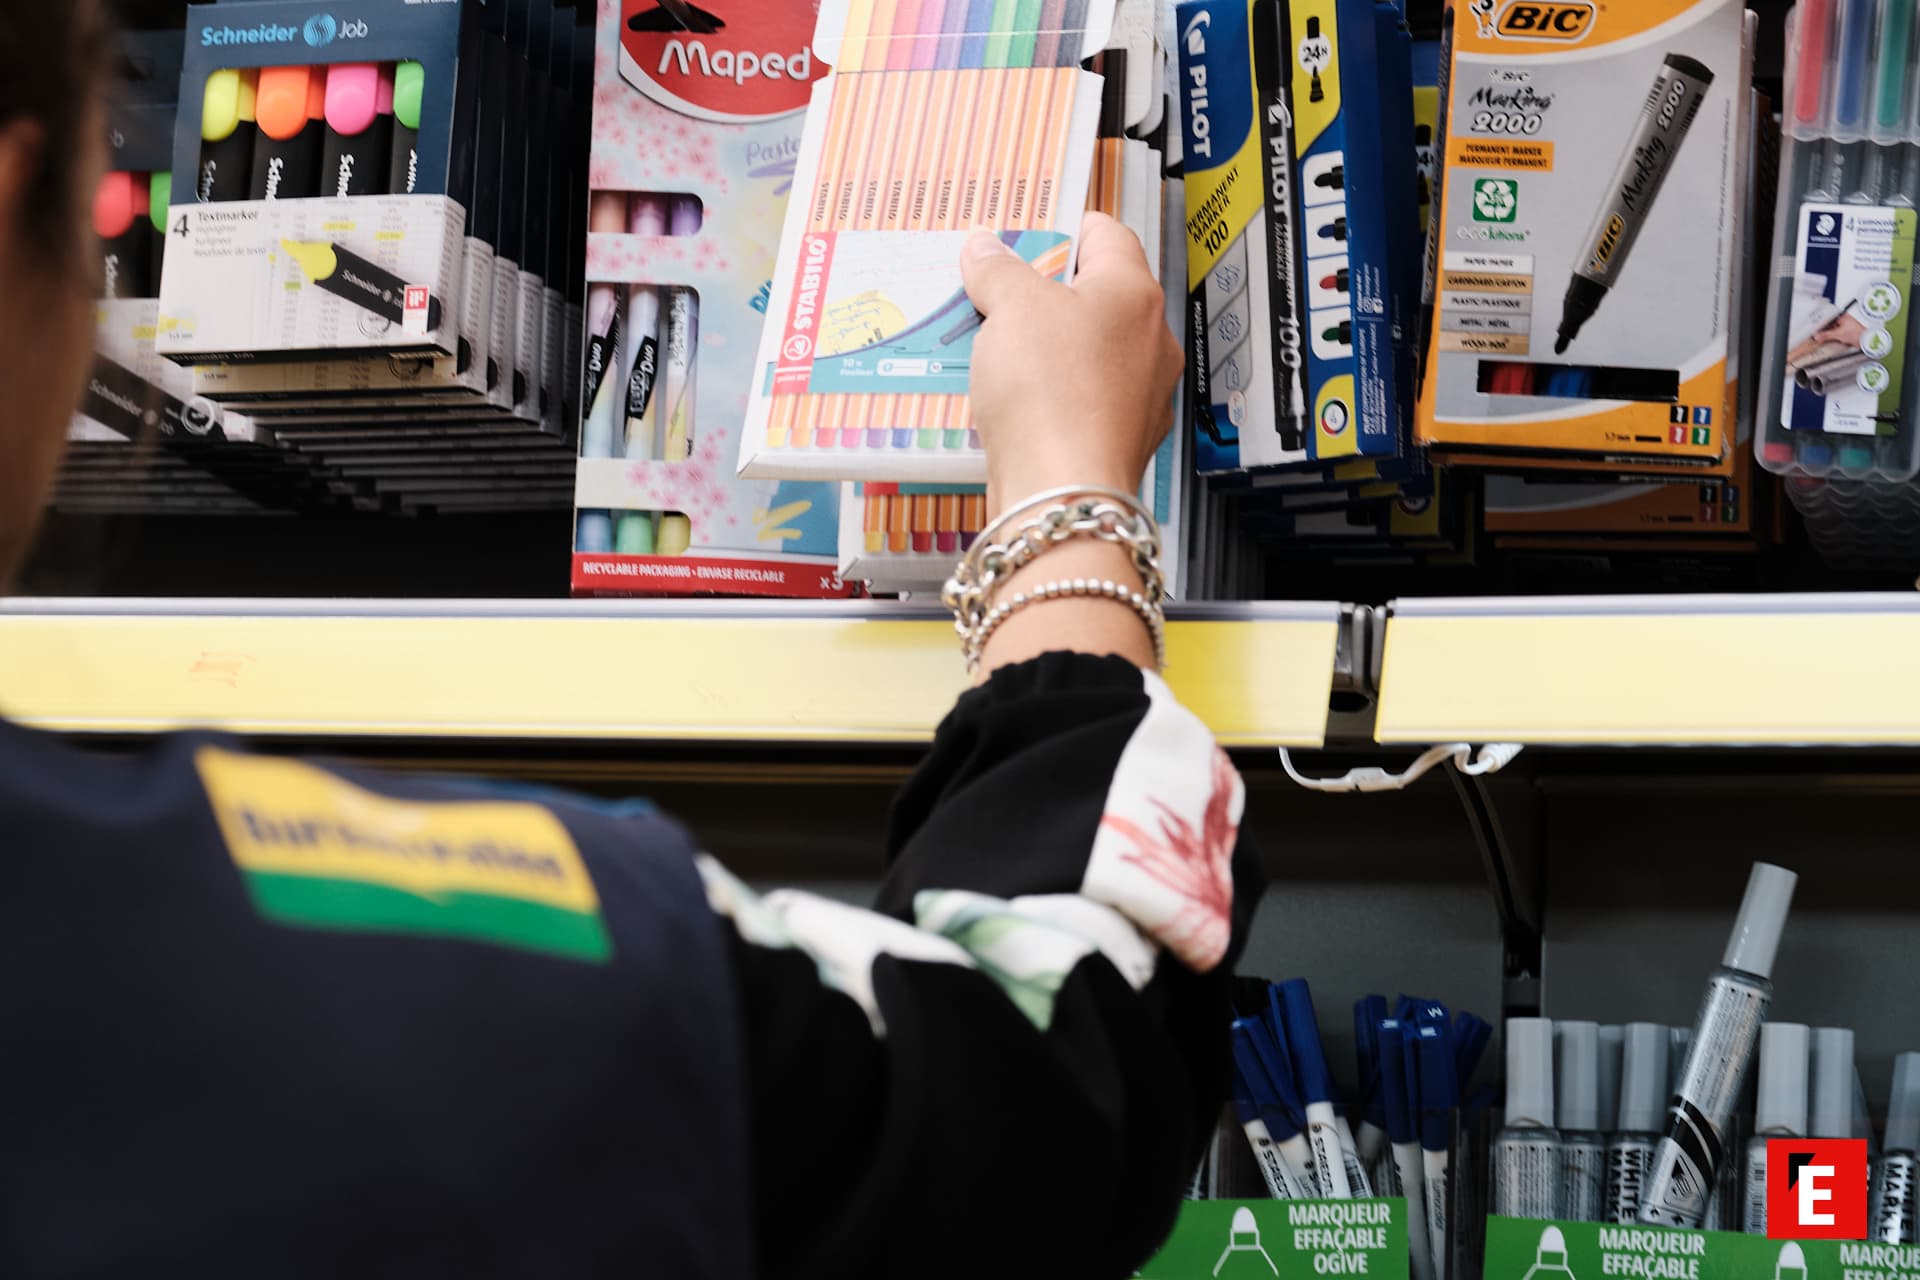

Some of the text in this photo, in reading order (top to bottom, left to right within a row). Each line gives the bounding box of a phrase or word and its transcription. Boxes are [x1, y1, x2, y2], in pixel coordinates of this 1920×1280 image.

[201, 19, 368, 46] Schneider Job
[658, 39, 810, 85] Maped
[1189, 64, 1211, 158] PILOT
[1468, 86, 1552, 111] Marking
[1656, 79, 1686, 130] 2000
[1470, 110, 1542, 135] 2000
[1269, 136, 1289, 213] PILOT
[1621, 135, 1668, 212] Marking
[1186, 168, 1239, 235] PERMANENT
[1193, 194, 1231, 244] MARKER
[173, 210, 258, 237] 4 Textmarker
[1205, 220, 1230, 256] 100
[793, 238, 828, 330] STABILO
[1279, 316, 1302, 369] 100
[583, 562, 638, 576] RECYCLABLE
[639, 563, 691, 579] PACKAGING
[697, 566, 734, 581] ENVASE
[1621, 1149, 1642, 1220] WHITE
[1288, 1203, 1391, 1231] MARQUEUR
[1294, 1227, 1387, 1254] EFFAÇABLE
[1598, 1228, 1705, 1260] MARQUEUR
[1314, 1252, 1368, 1274] OGIVE
[1602, 1253, 1700, 1280] EFFAÇABLE
